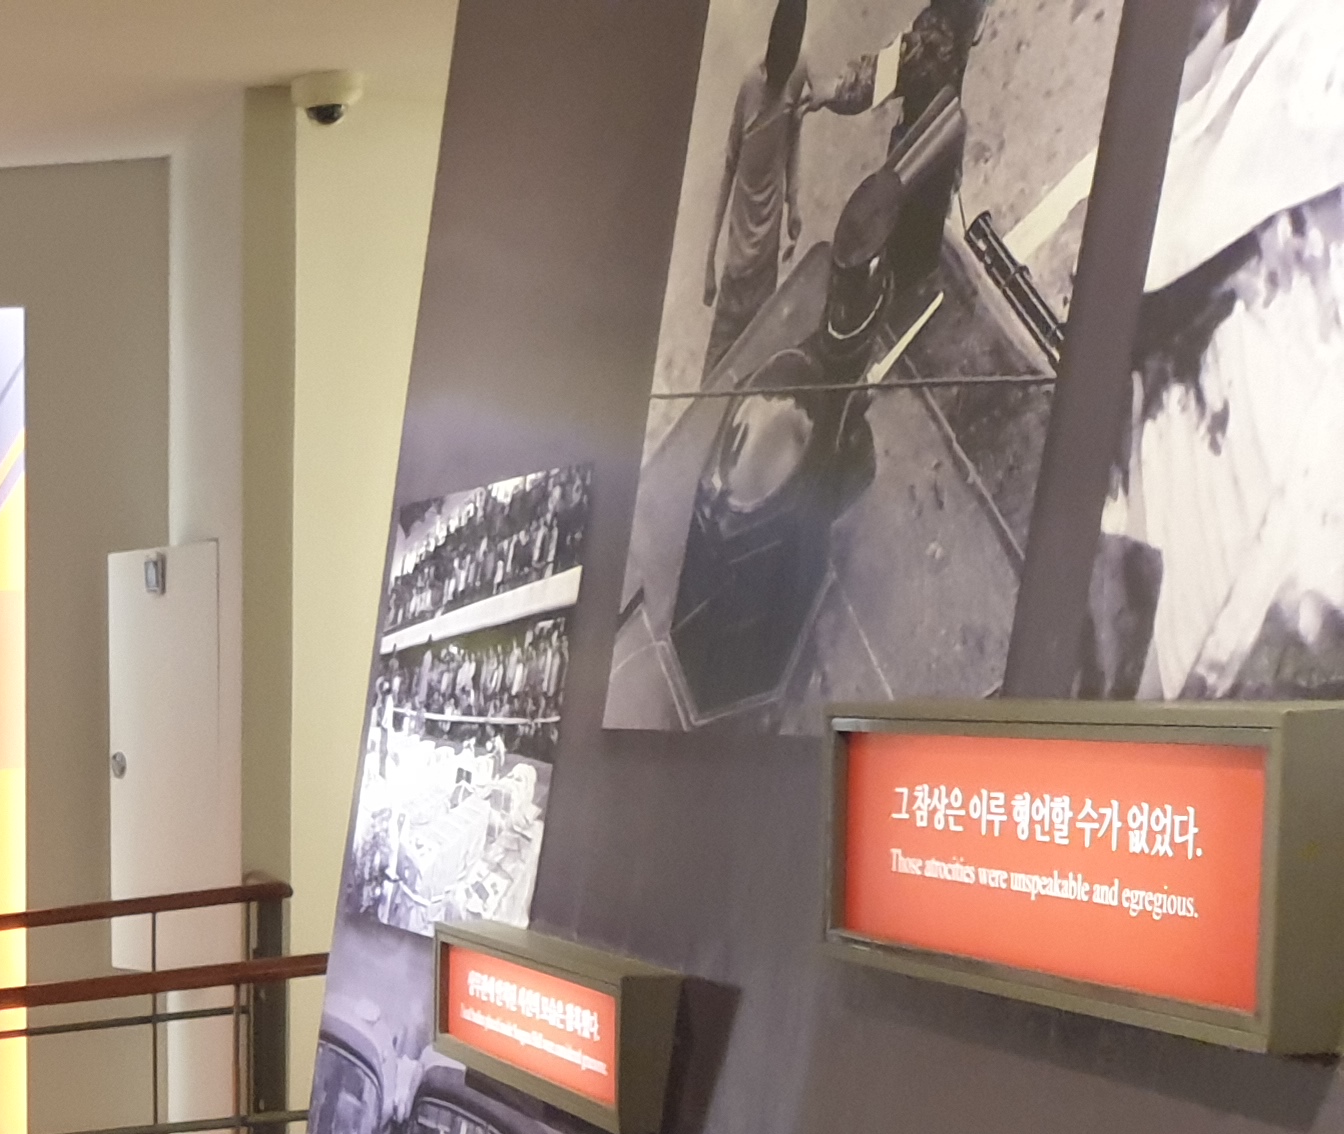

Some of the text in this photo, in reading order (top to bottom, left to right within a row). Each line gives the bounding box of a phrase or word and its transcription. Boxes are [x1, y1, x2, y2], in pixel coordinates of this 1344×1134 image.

[891, 783, 1203, 860] 그 참상은 이루 형언할 수가 없었다.
[890, 848, 1199, 920] Those atrocities were unspeakable and egregious.
